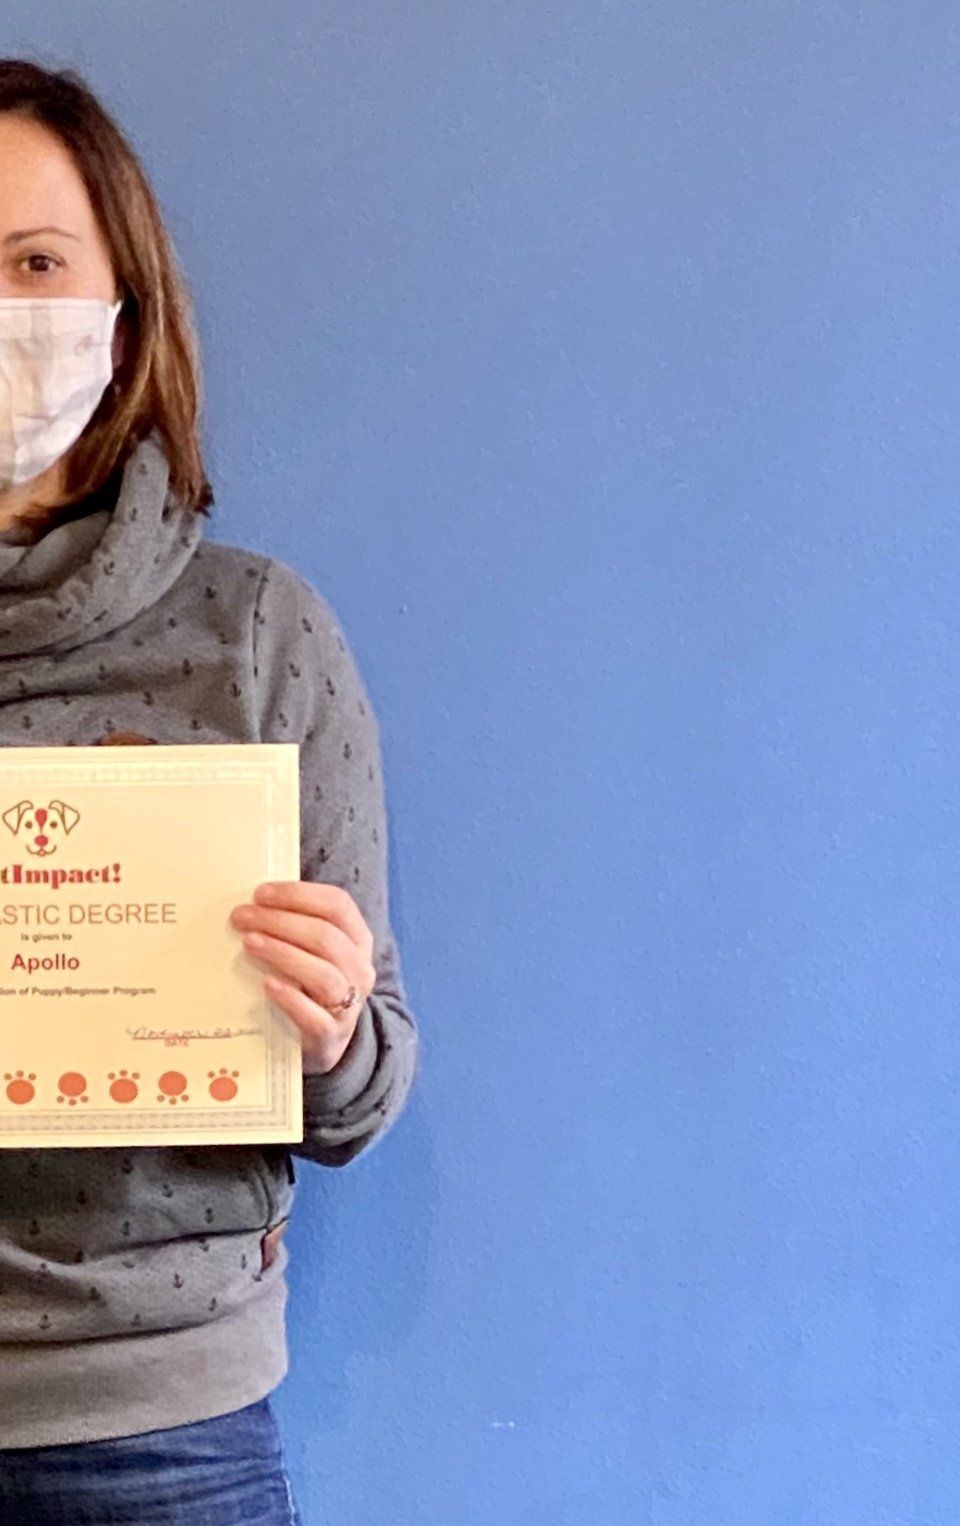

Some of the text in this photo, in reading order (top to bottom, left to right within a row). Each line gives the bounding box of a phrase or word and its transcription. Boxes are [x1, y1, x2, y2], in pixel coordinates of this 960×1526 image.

[69, 903, 178, 924] DEGREE
[32, 932, 59, 943] given
[61, 932, 72, 941] to
[11, 953, 80, 974] Apollo
[19, 986, 29, 996] of
[113, 985, 156, 996] Program
